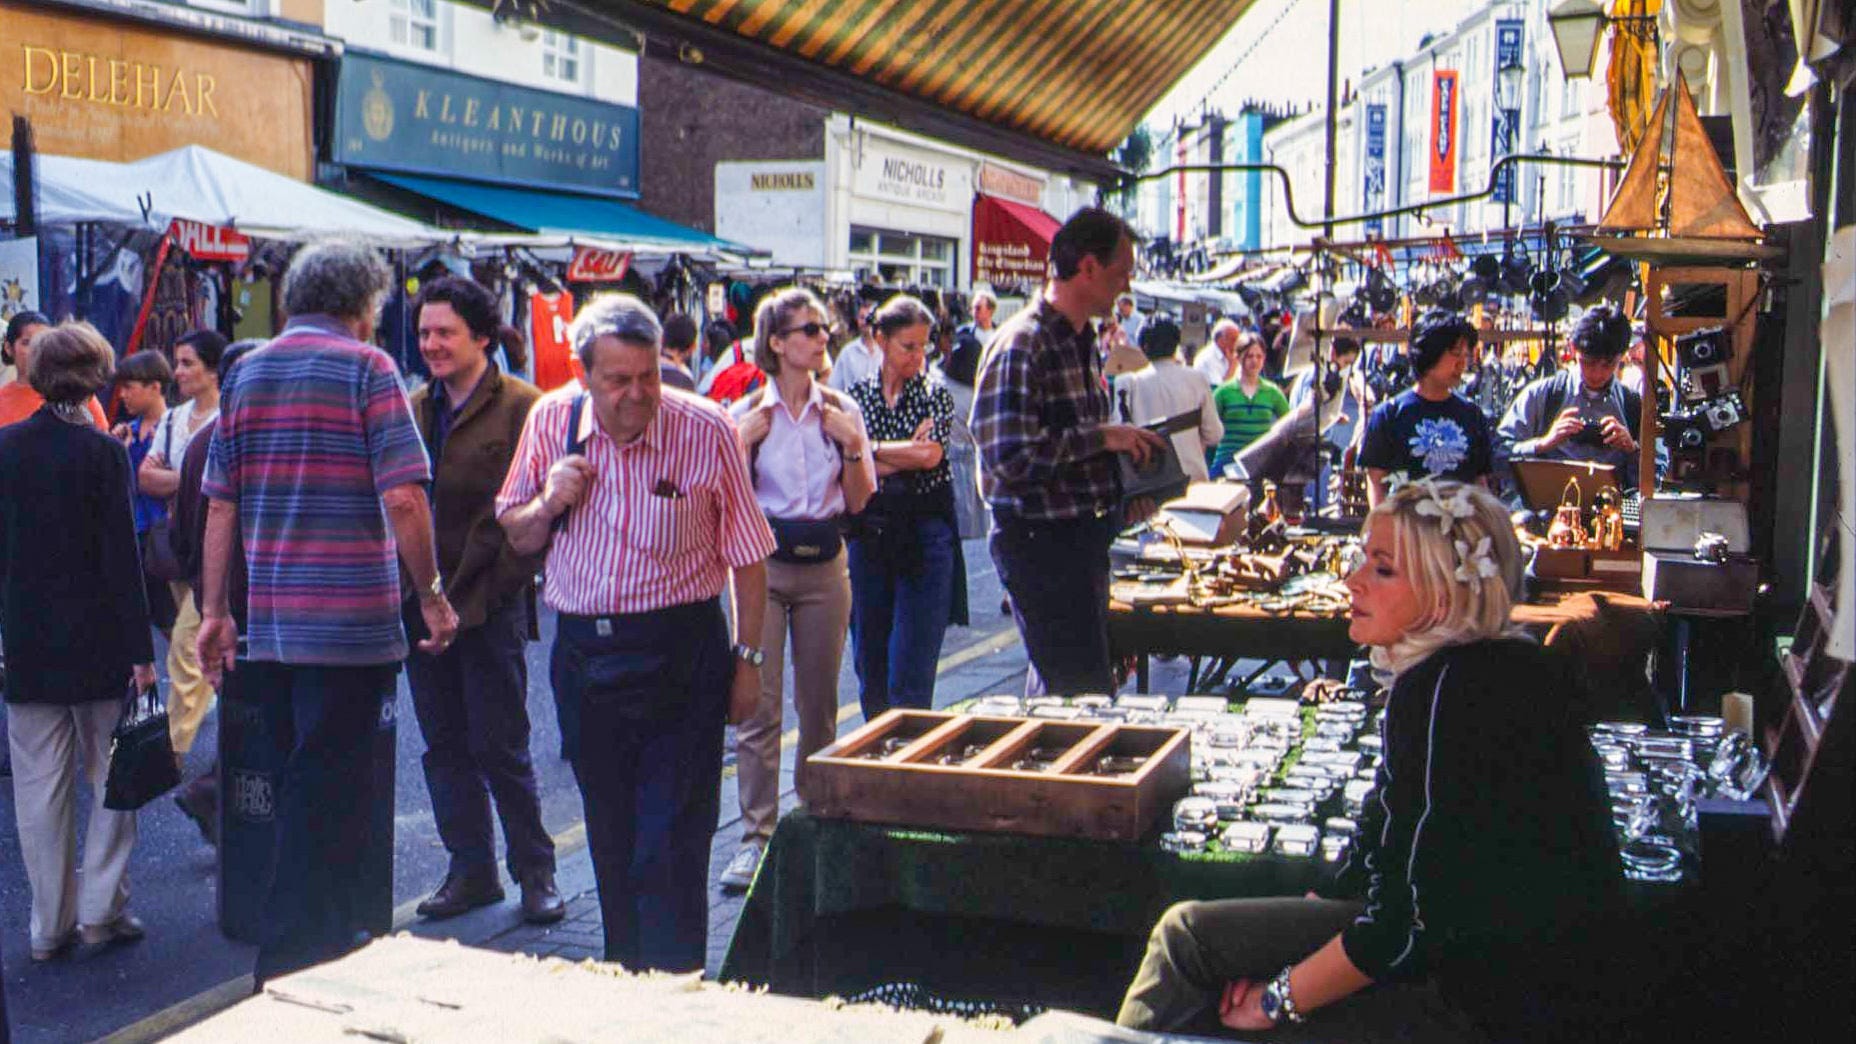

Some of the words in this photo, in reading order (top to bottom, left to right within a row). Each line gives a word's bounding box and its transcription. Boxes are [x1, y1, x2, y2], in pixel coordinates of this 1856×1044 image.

[22, 44, 218, 118] DELEHAR
[414, 88, 622, 151] KLEANTHOUS
[751, 173, 815, 190] NICHOLLS
[883, 157, 945, 190] NICHOLLS
